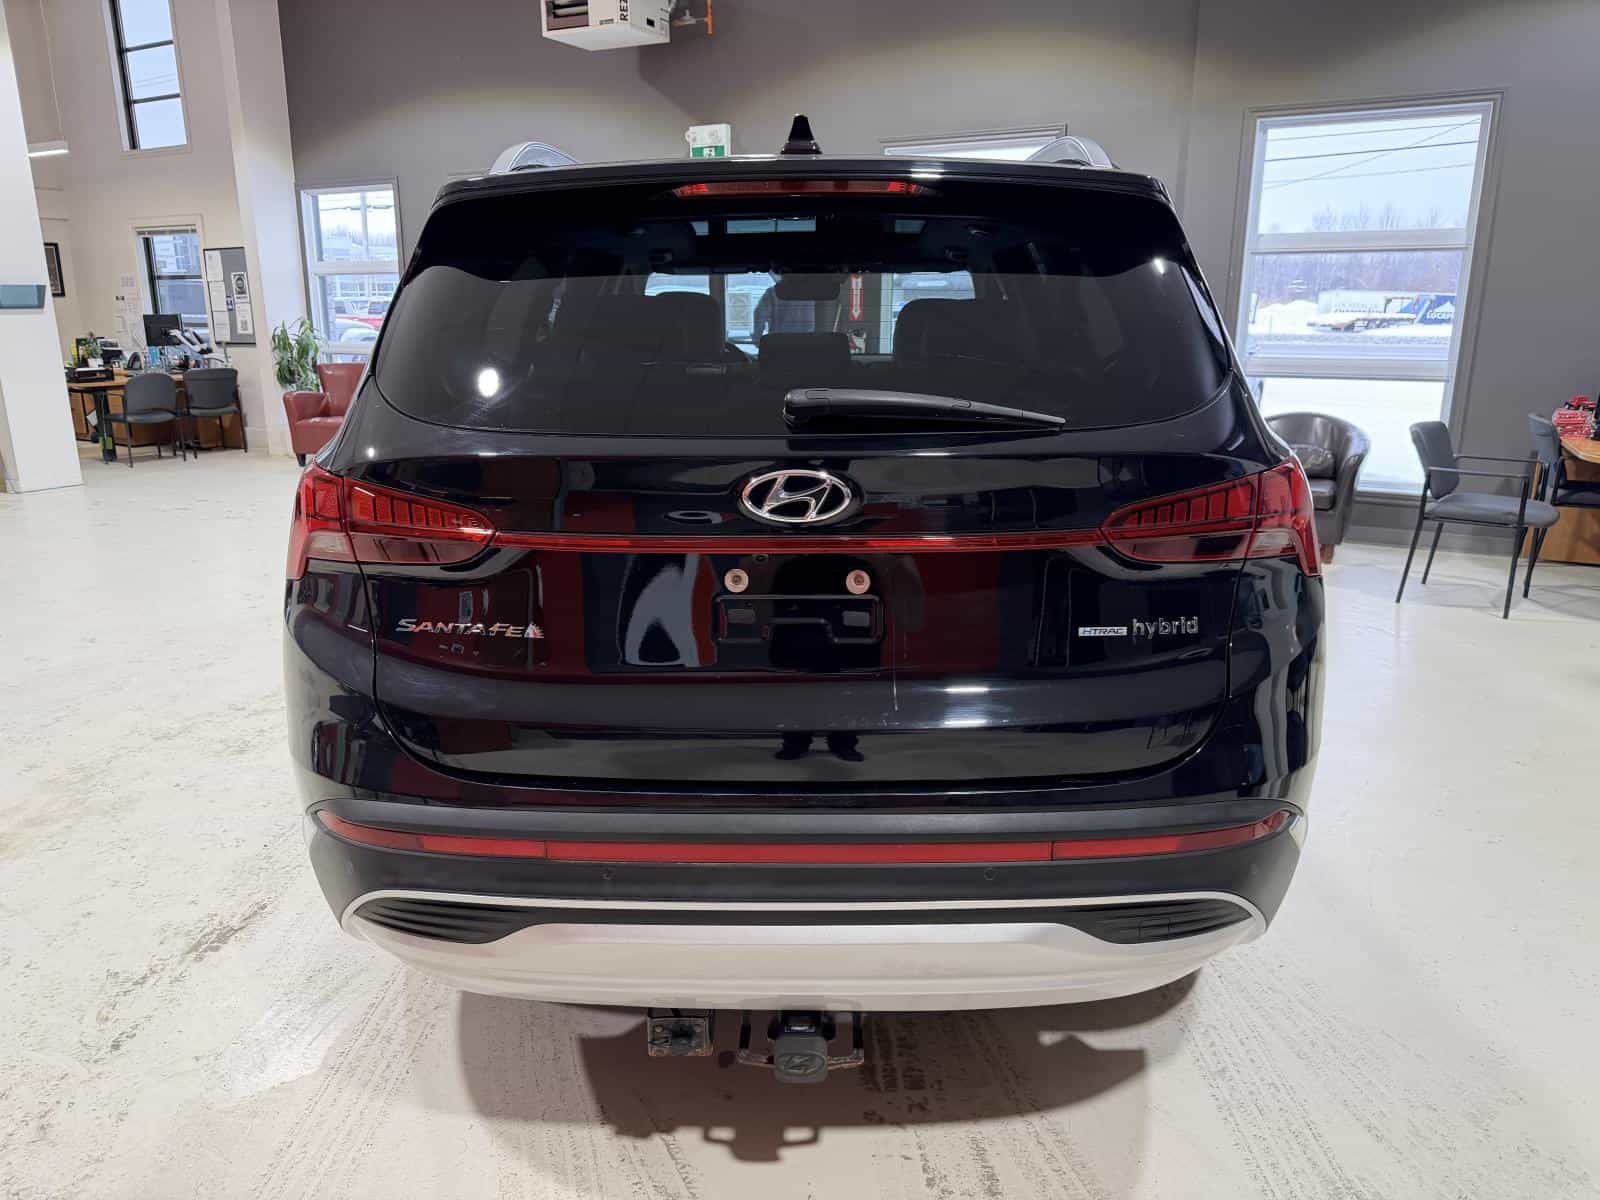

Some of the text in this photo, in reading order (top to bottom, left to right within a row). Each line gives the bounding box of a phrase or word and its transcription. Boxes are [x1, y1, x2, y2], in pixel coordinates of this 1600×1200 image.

[395, 618, 486, 636] SANTA
[1081, 616, 1199, 639] HTRAC hybrid
